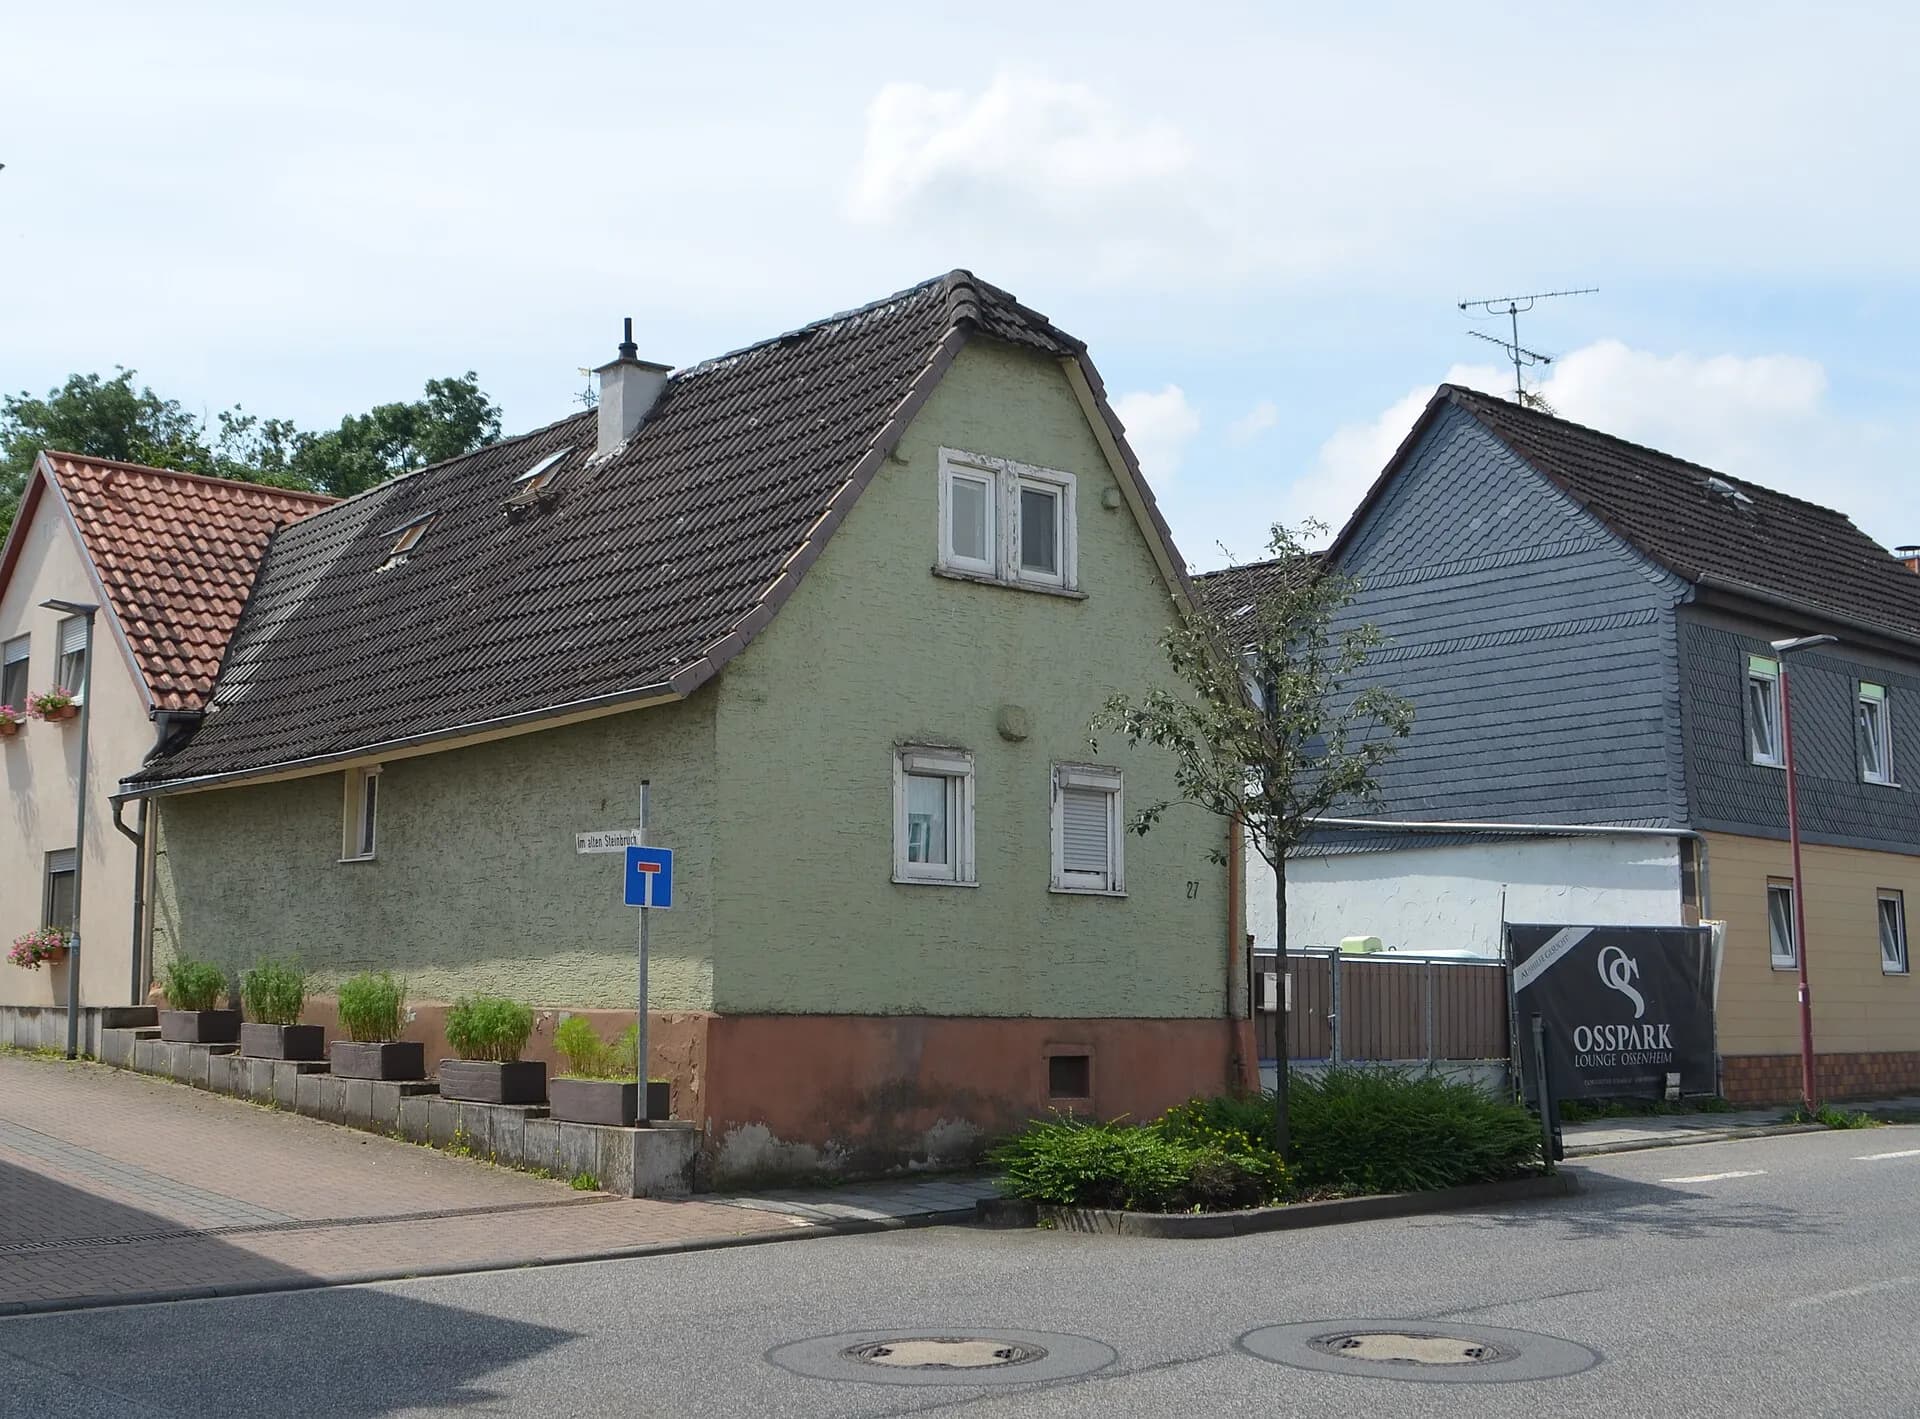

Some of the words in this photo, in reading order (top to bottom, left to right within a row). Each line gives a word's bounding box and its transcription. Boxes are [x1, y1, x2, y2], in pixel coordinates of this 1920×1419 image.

[577, 836, 586, 849] Im
[587, 835, 603, 849] alten
[604, 833, 637, 848] Steinbruch
[1186, 880, 1200, 900] 27
[1573, 1023, 1673, 1053] OSSPARK
[1575, 1053, 1617, 1068] LOUNGE
[1620, 1051, 1673, 1066] OSSENHEIM
